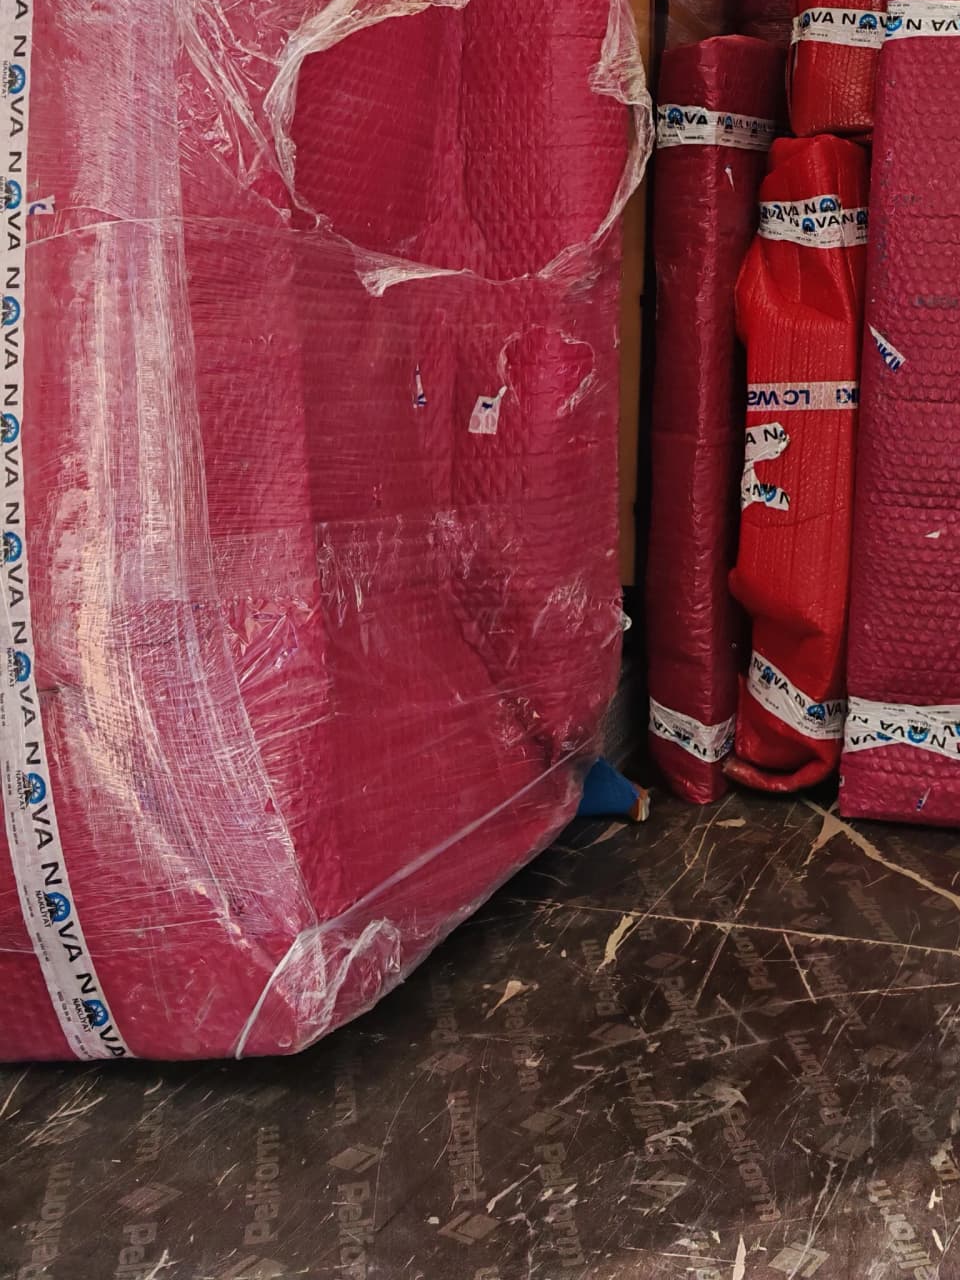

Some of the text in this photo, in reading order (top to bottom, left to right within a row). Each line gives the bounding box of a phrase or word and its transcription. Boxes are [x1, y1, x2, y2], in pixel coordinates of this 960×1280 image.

[7, 35, 28, 138] NOVA
[4, 150, 23, 252] NOVA
[1, 267, 21, 371] NOVA
[1, 383, 21, 489] NOVA
[2, 502, 25, 609] NOVA
[11, 621, 37, 728] NOVA
[879, 719, 947, 748] NOVA
[24, 740, 54, 851] NOVA
[40, 861, 83, 964] NOVA
[75, 972, 127, 1060] NOVA
